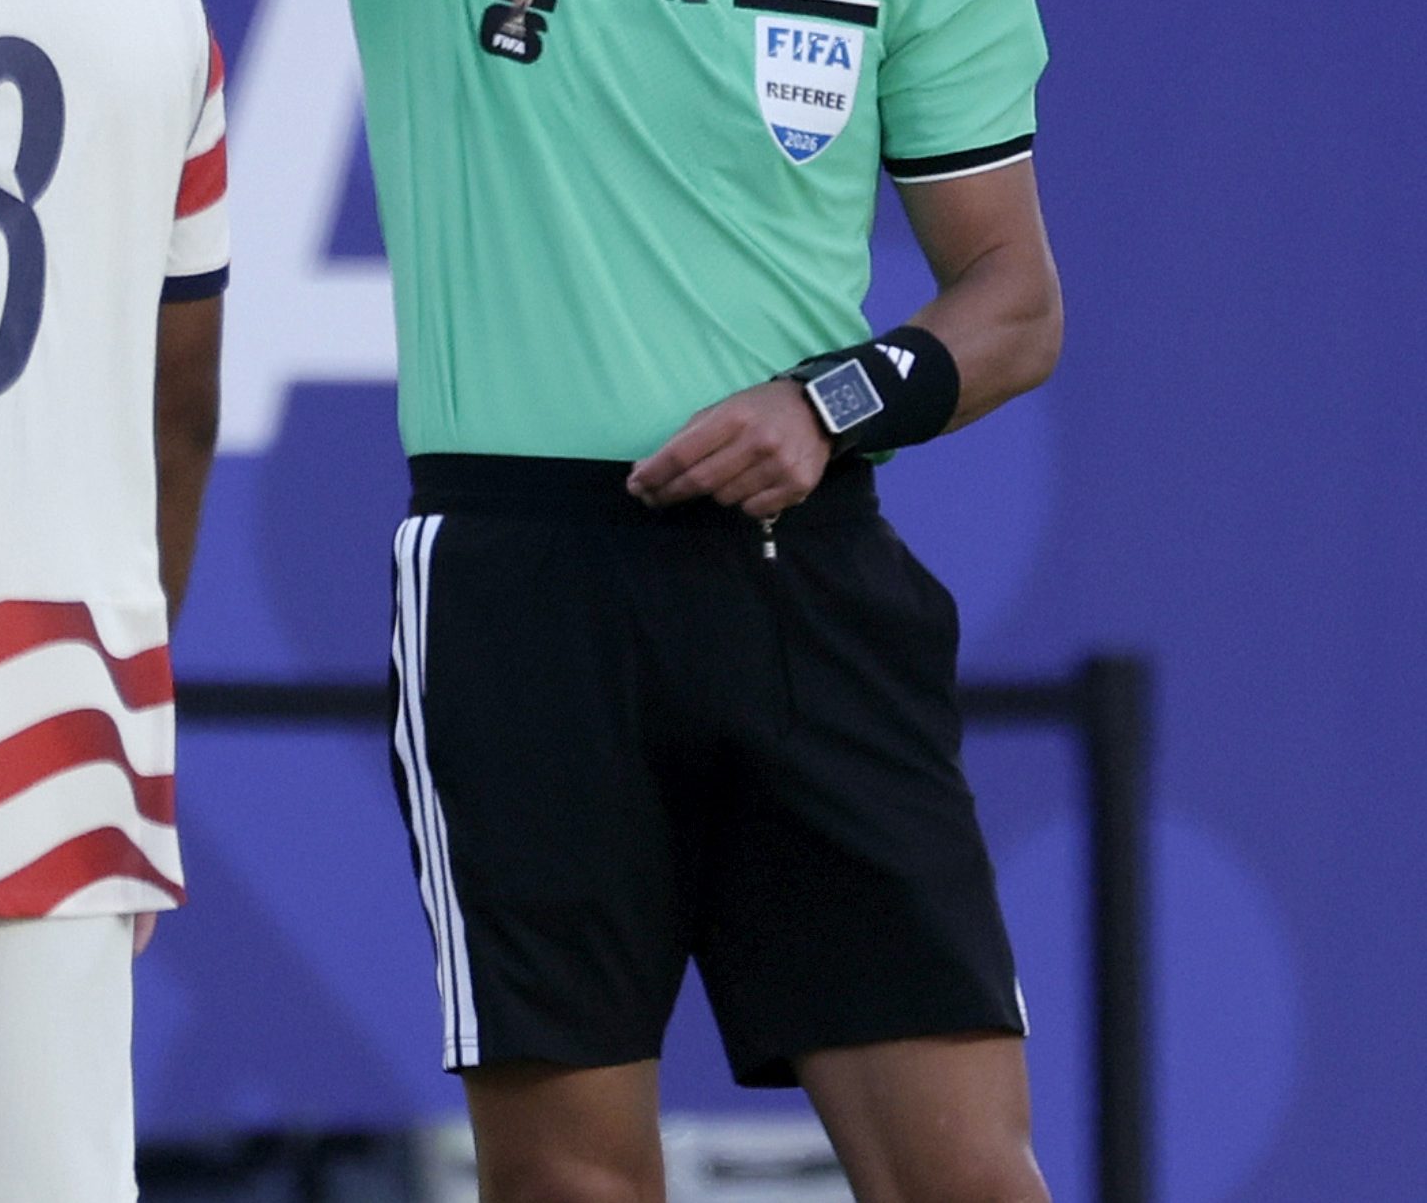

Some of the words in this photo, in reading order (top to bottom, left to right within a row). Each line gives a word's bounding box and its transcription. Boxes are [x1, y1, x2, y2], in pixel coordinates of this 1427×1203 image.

[767, 26, 852, 70] FIFA
[766, 80, 847, 112] REFEREE
[783, 129, 819, 152] 2026
